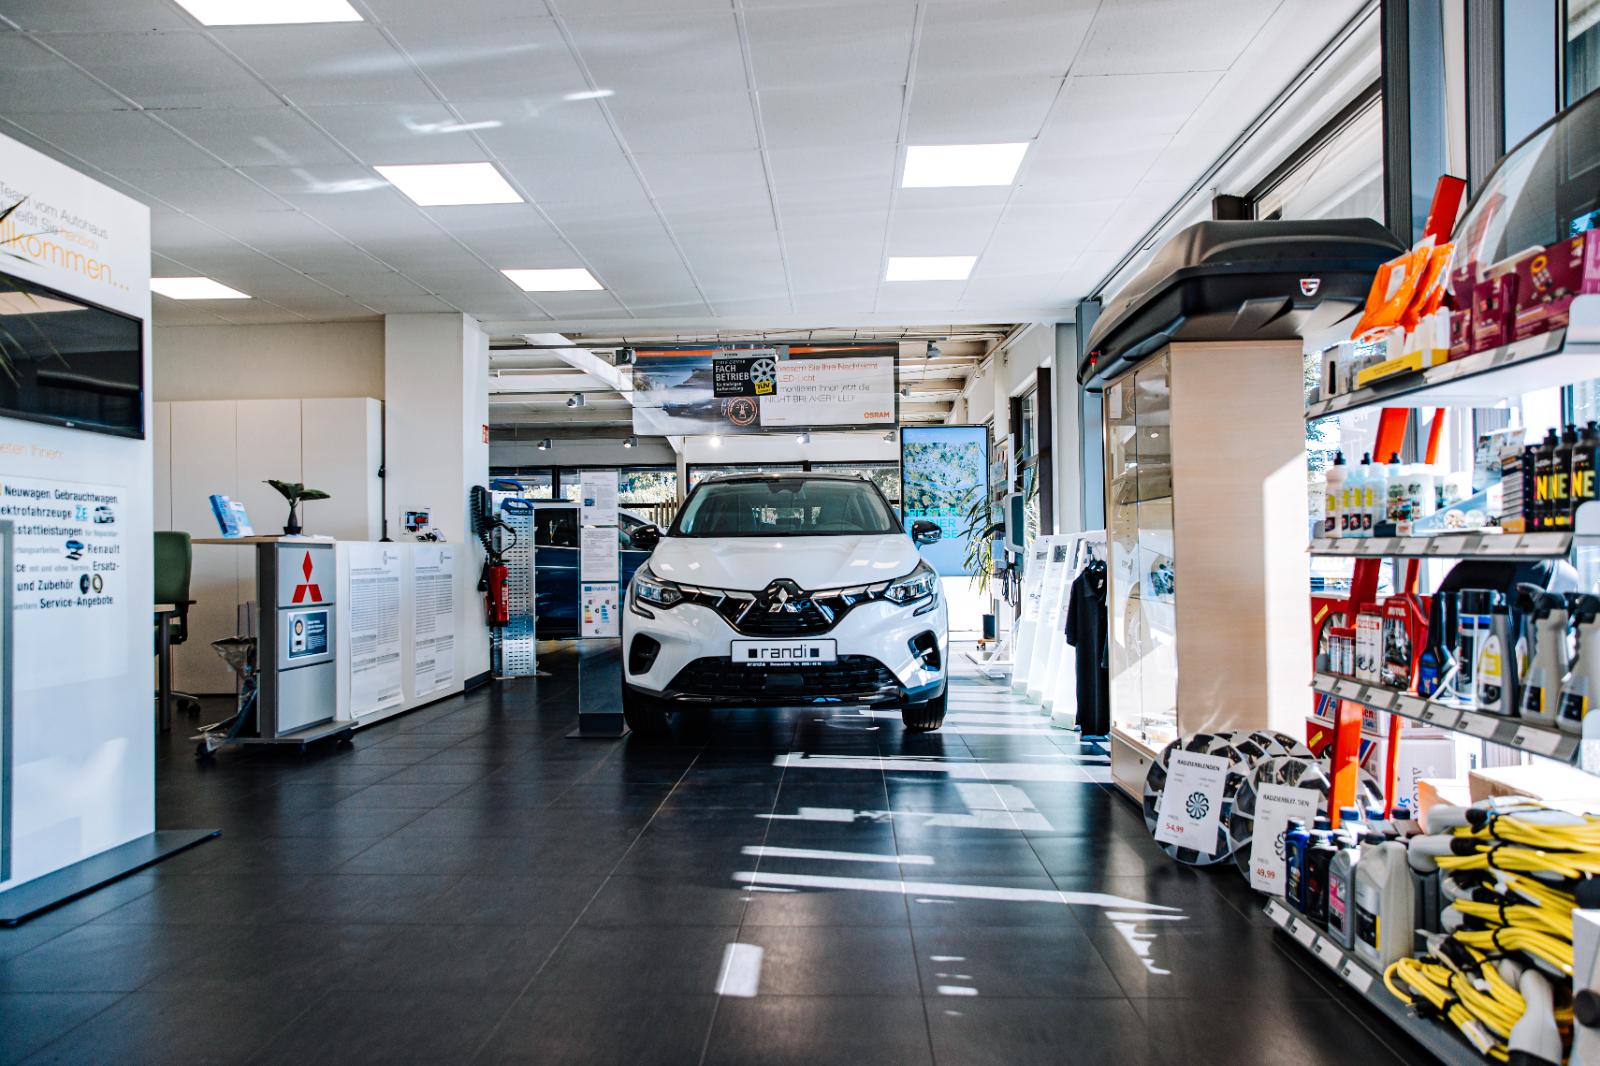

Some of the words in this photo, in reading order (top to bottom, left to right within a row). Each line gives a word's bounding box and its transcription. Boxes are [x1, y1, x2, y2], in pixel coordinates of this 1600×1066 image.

[33, 199, 58, 219] vom
[60, 209, 109, 240] Autohaus
[715, 365, 736, 373] FACH
[716, 372, 750, 382] BETRIEB
[757, 382, 771, 390] TÜV
[840, 383, 858, 393] jetzt
[863, 411, 890, 419] OSRAM
[5, 485, 50, 501] Neuwagen
[54, 488, 118, 504] Gebrauchtwagen
[87, 543, 120, 554] Renault
[38, 579, 74, 592] Zubehör
[40, 596, 114, 610] Service-Angebote
[760, 645, 808, 658] randi
[1165, 822, 1184, 833] 54,99
[1256, 867, 1276, 880] 49,99
